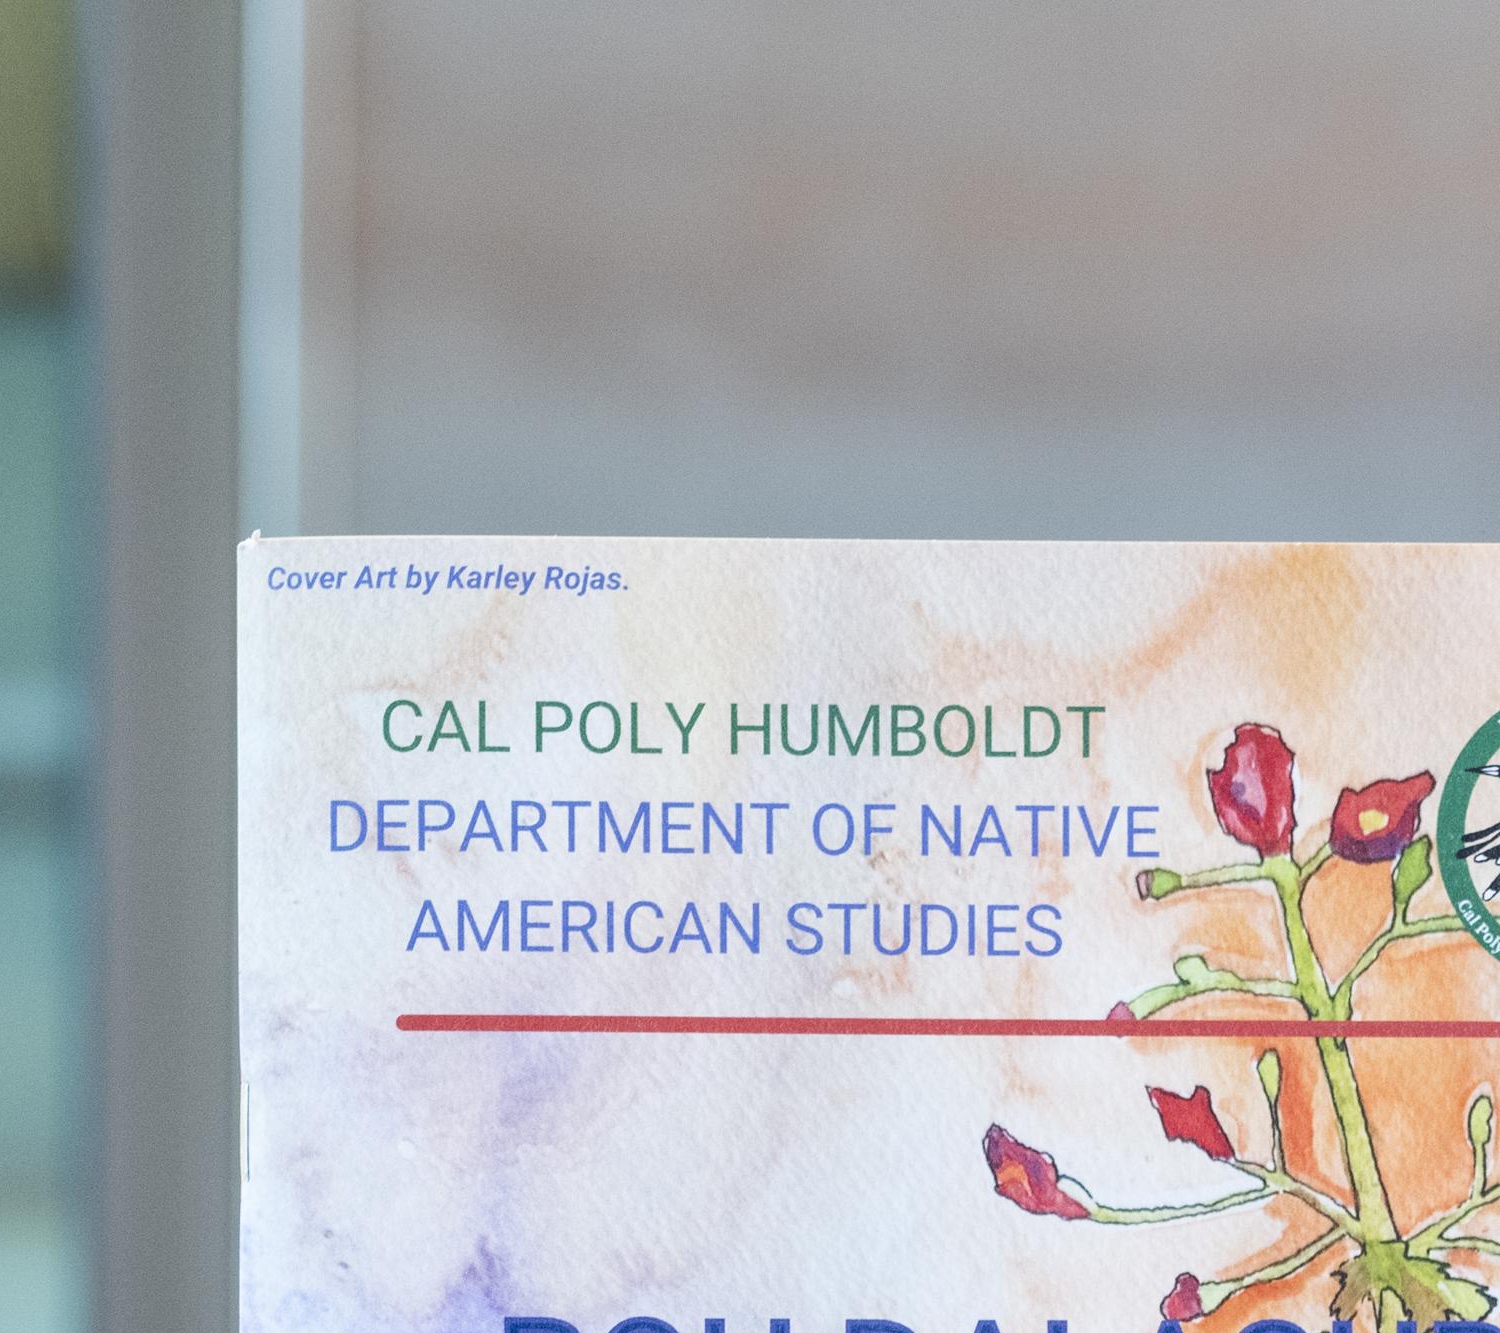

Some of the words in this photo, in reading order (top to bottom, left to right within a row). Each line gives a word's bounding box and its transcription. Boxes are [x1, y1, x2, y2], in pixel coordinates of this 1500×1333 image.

[266, 564, 348, 591] Cover
[353, 564, 398, 591] Art
[405, 564, 440, 597] by
[446, 564, 536, 597] Karley
[544, 566, 630, 598] Rojas.
[381, 700, 512, 753] CAL
[534, 702, 706, 755] POLY
[728, 702, 1106, 759] HUMBOLDT
[328, 800, 790, 855] DEPARTMENT
[812, 803, 896, 855] OF
[920, 804, 1161, 859] NATIVE
[405, 900, 761, 955] AMERICAN
[785, 902, 1063, 958] STUDIES
[1458, 899, 1478, 927] Cal
